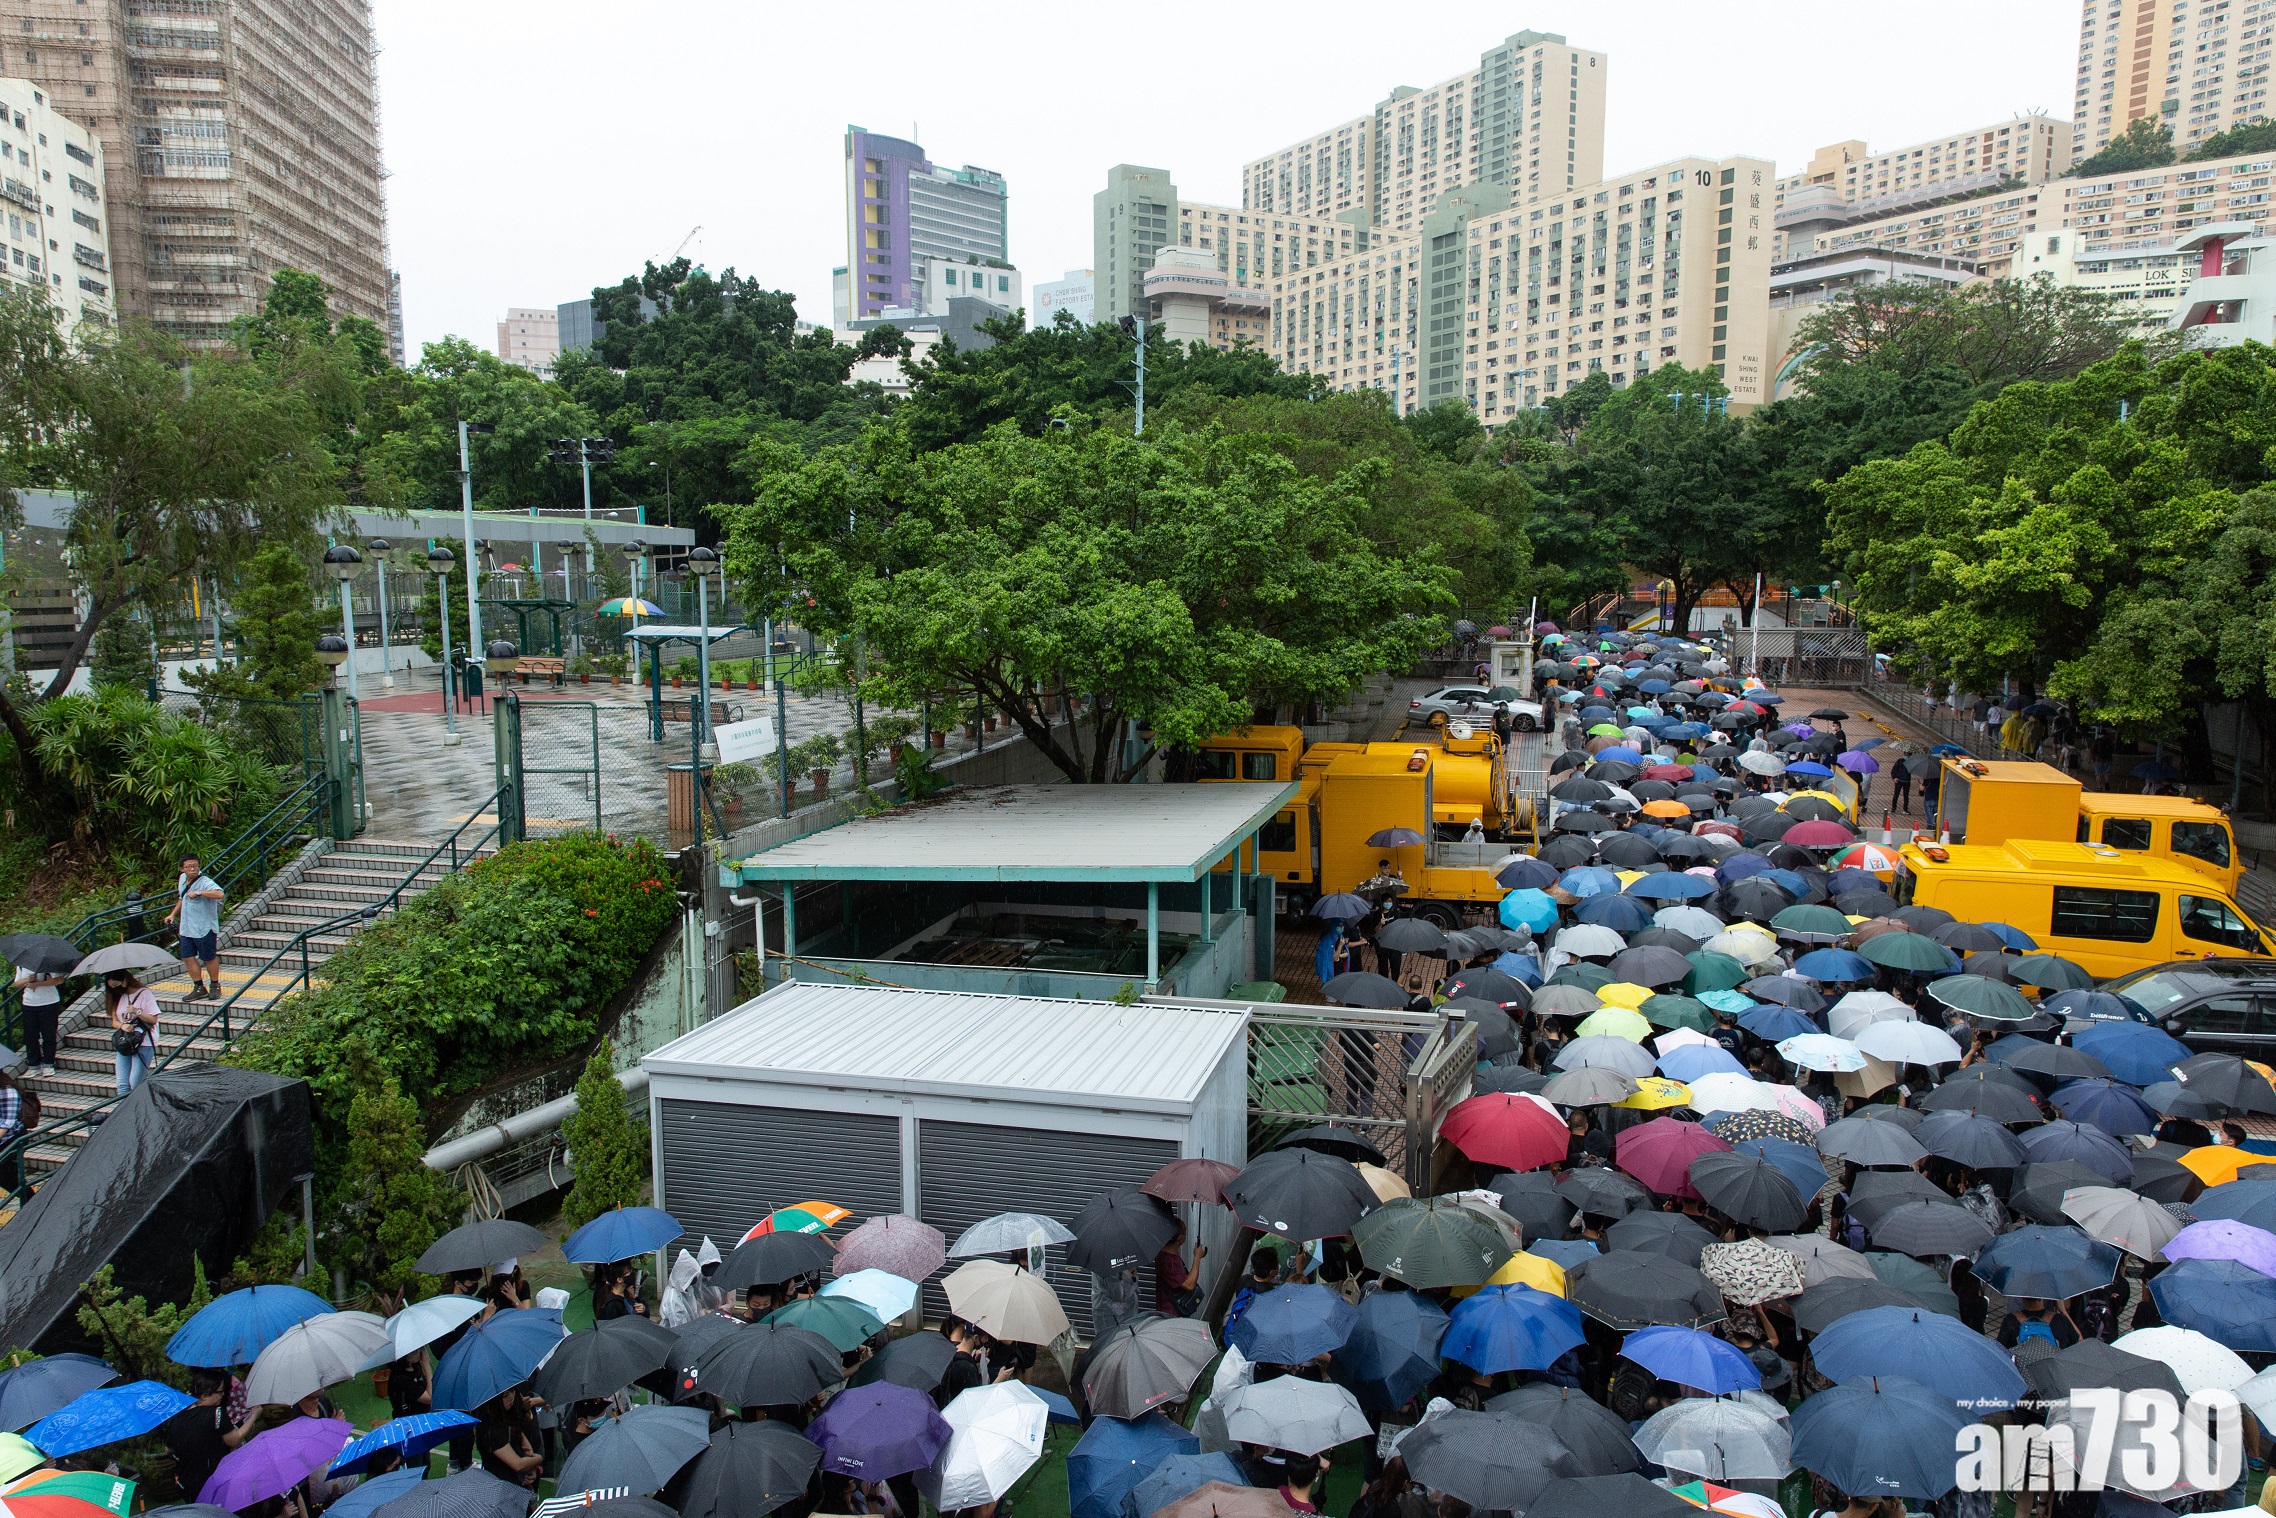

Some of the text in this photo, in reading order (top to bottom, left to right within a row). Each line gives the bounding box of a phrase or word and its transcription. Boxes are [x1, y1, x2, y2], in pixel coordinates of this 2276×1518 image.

[1590, 57, 1596, 68] 8
[2039, 123, 2045, 134] 6
[1695, 169, 1711, 187] 10
[2038, 185, 2045, 194] 7
[1119, 203, 1124, 215] 9
[1747, 169, 1762, 251] 葵盛西邨
[2145, 267, 2196, 281] LOK SI
[1055, 285, 1087, 297] CHUN SHING
[1055, 293, 1094, 306] FACTORY ESTA
[1742, 355, 1759, 363] KWAI
[1738, 365, 1758, 373] SHING
[1734, 385, 1757, 393] ESTATE
